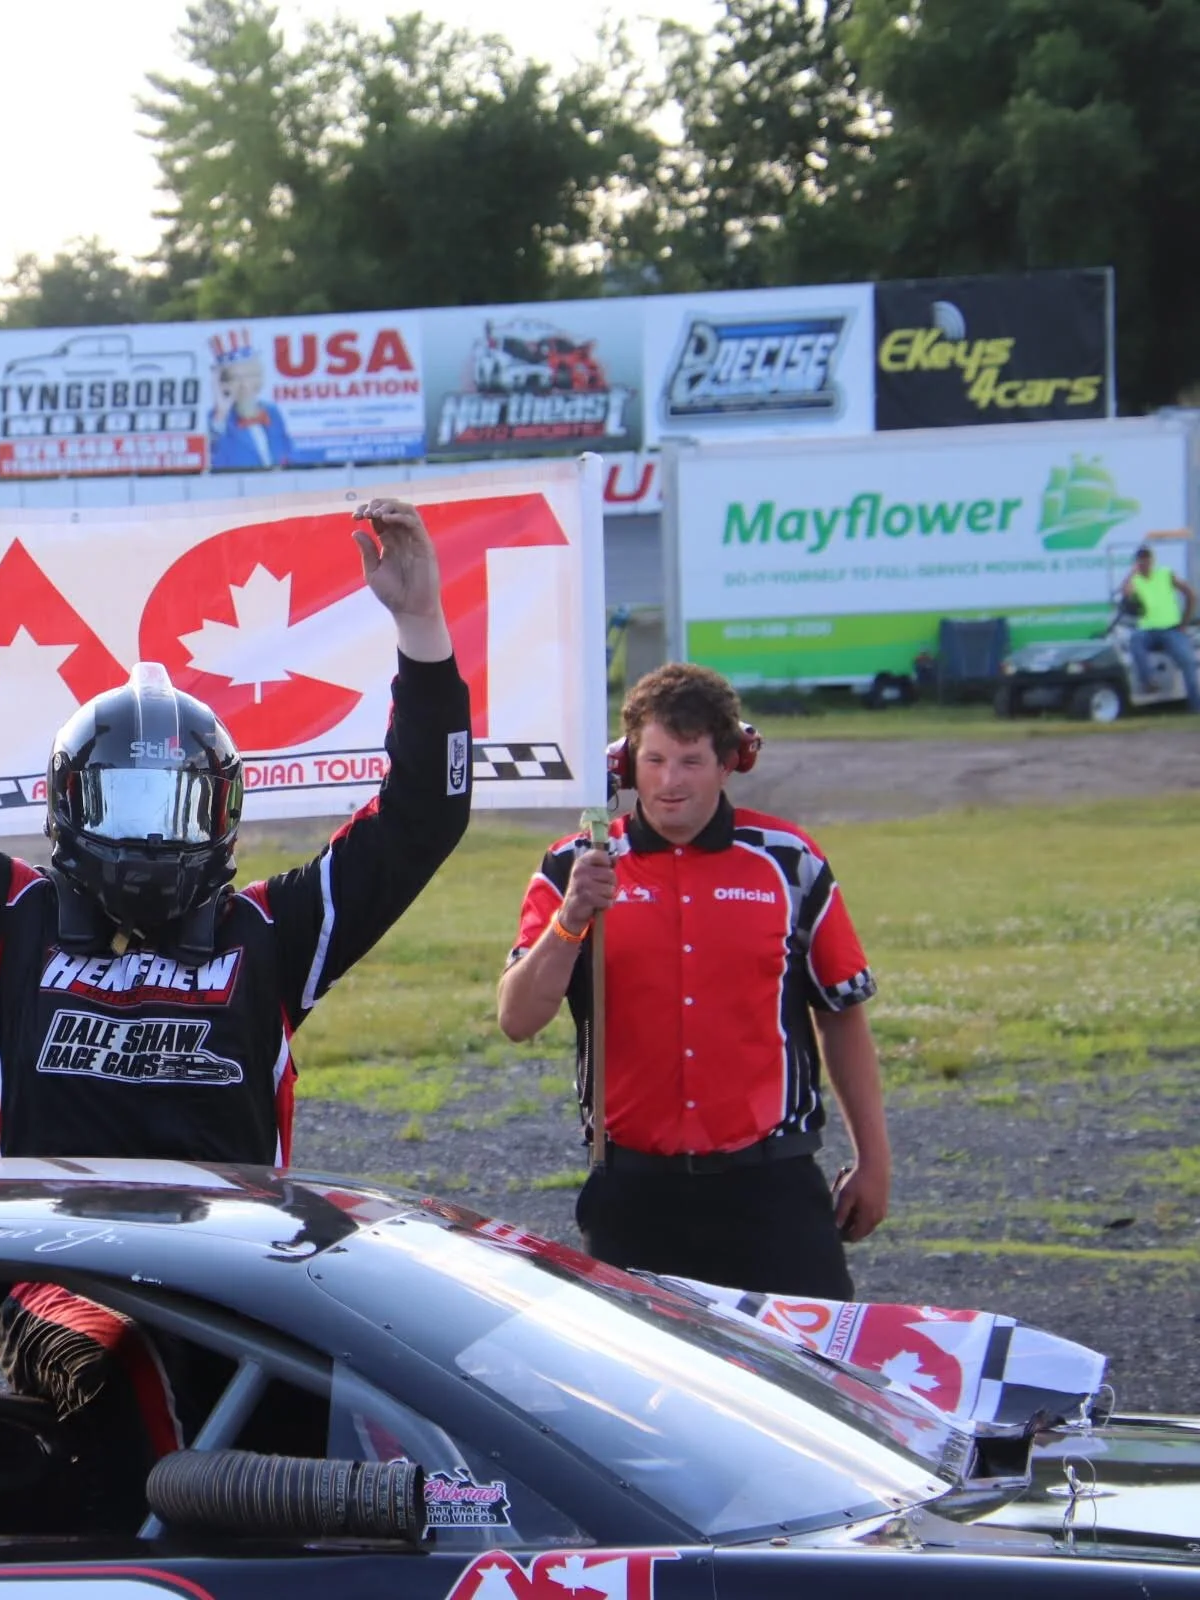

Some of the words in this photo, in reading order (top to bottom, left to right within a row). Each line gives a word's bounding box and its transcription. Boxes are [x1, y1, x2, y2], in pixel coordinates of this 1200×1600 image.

[274, 329, 414, 377] USA
[273, 379, 420, 400] INSULATION
[722, 493, 1022, 553] Mayflower
[853, 565, 872, 581] TO
[129, 736, 186, 762] Stilo
[244, 762, 304, 788] DIAN
[713, 888, 776, 904] Official
[52, 1015, 120, 1049] DALE
[121, 1023, 205, 1053] SHAW
[43, 1046, 99, 1071] RACE
[101, 1052, 162, 1078] CARS
[427, 1506, 451, 1515] ORT
[453, 1506, 489, 1515] TRACK
[453, 1514, 497, 1523] VIDEOS
